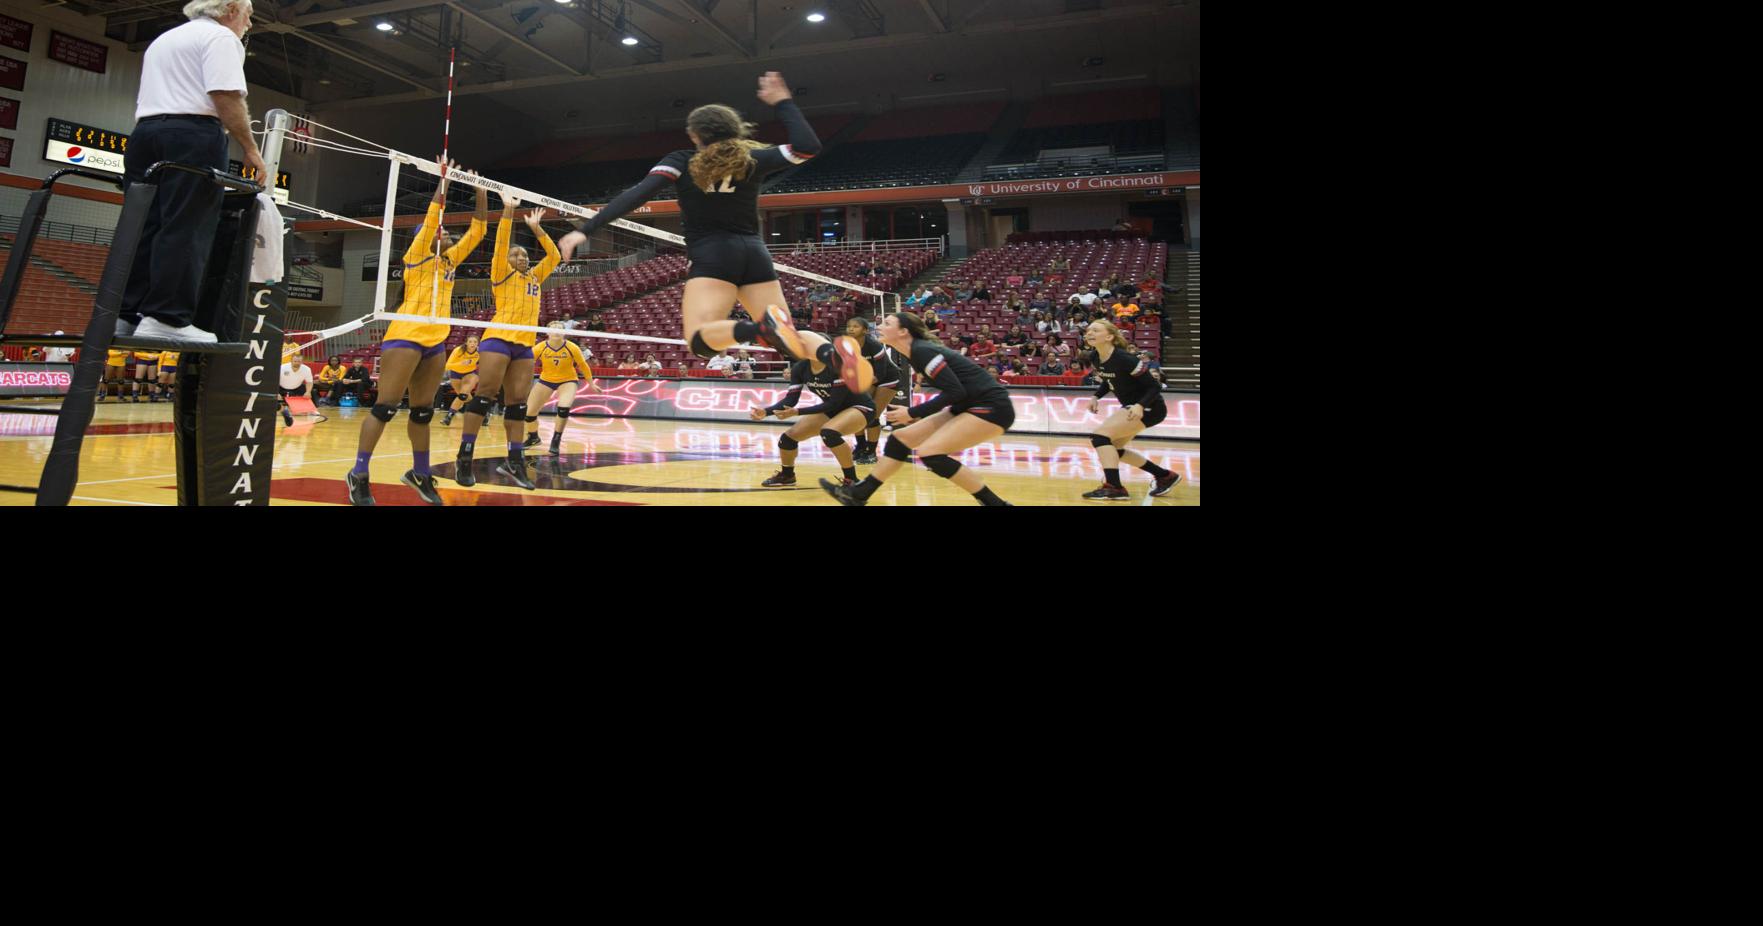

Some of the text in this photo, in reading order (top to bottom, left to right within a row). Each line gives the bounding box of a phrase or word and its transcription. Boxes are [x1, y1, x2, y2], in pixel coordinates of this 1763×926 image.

[88, 155, 121, 169] pepsi
[991, 182, 1060, 194] University
[1066, 179, 1081, 190] of
[1088, 174, 1164, 188] Cincinnati
[527, 282, 539, 297] 12
[0, 371, 71, 386] ARCATS
[230, 288, 272, 506] CINCINNA
